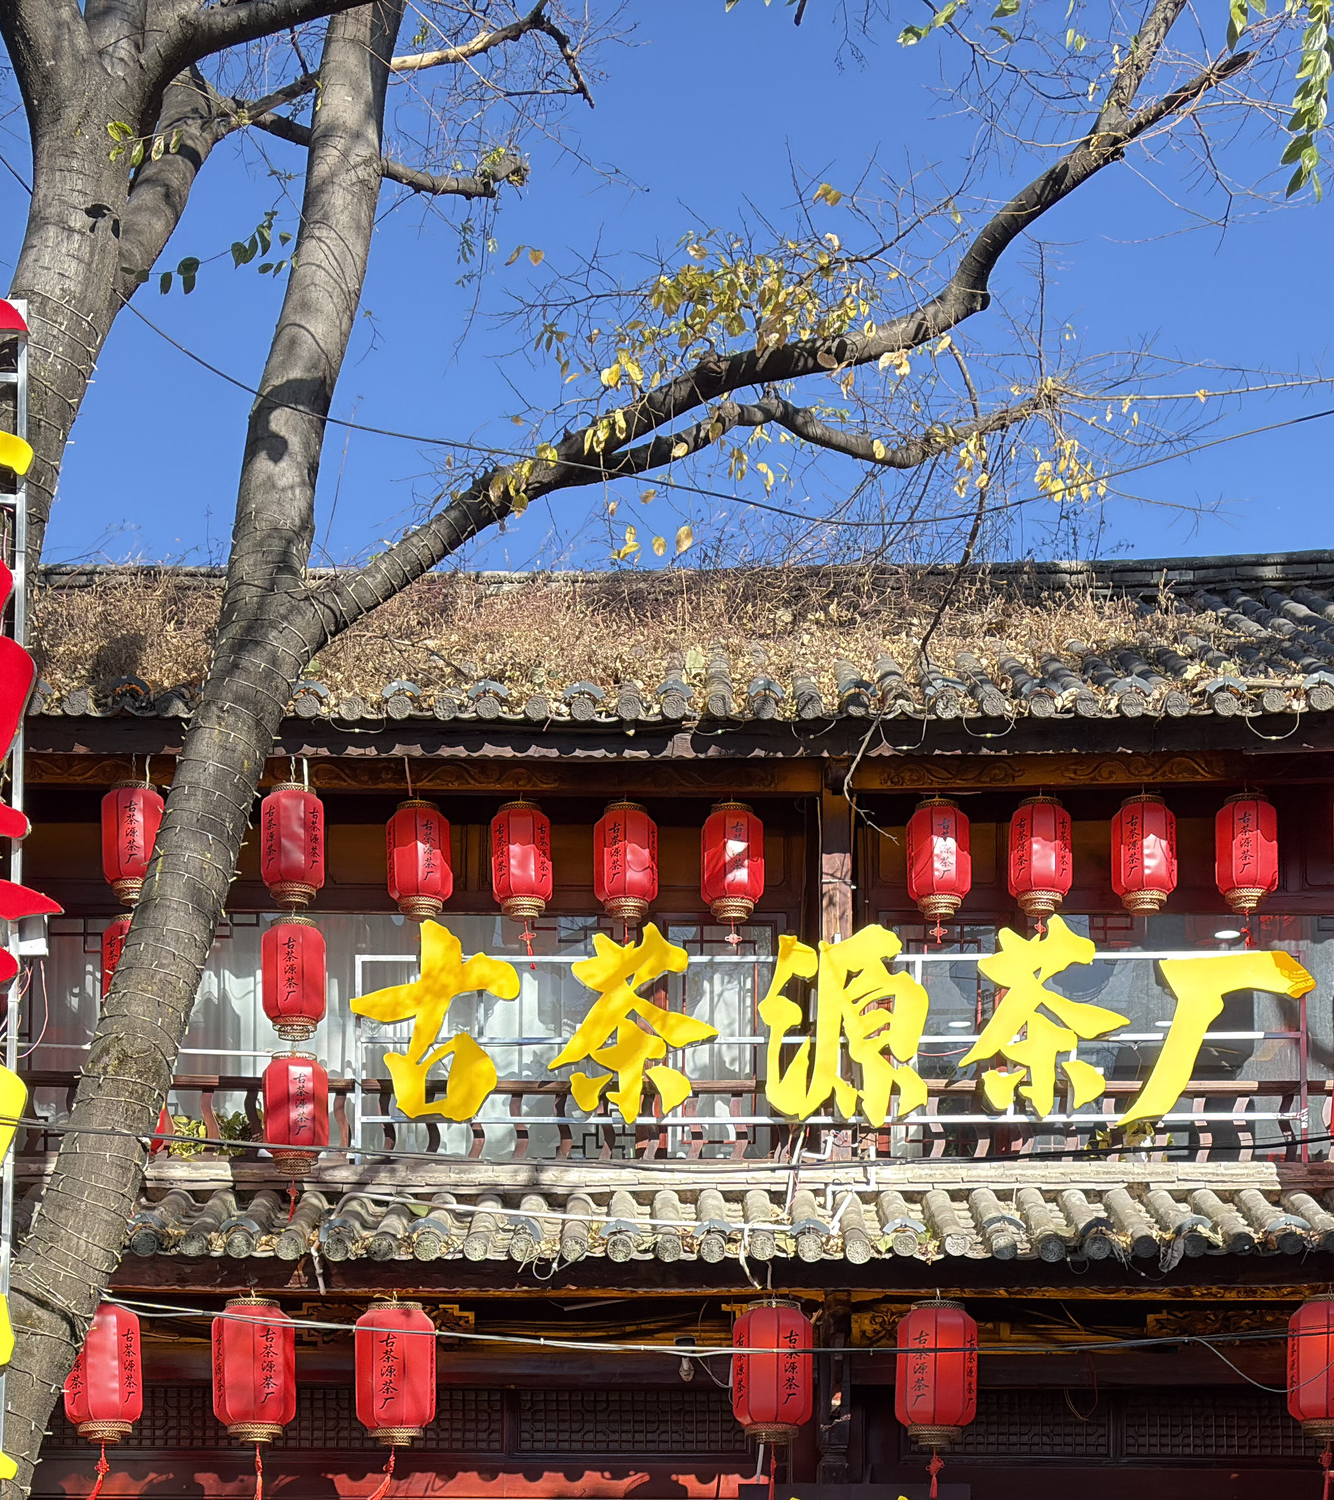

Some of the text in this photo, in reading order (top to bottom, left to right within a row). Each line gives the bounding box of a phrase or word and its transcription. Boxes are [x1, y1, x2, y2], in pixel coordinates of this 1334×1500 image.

[350, 914, 1317, 1128] 古茶源茶厂
[121, 1328, 138, 1404] 古茶源茶厂
[259, 1327, 279, 1404] 古茶源茶厂
[378, 1332, 399, 1411] 古茶源茶厂
